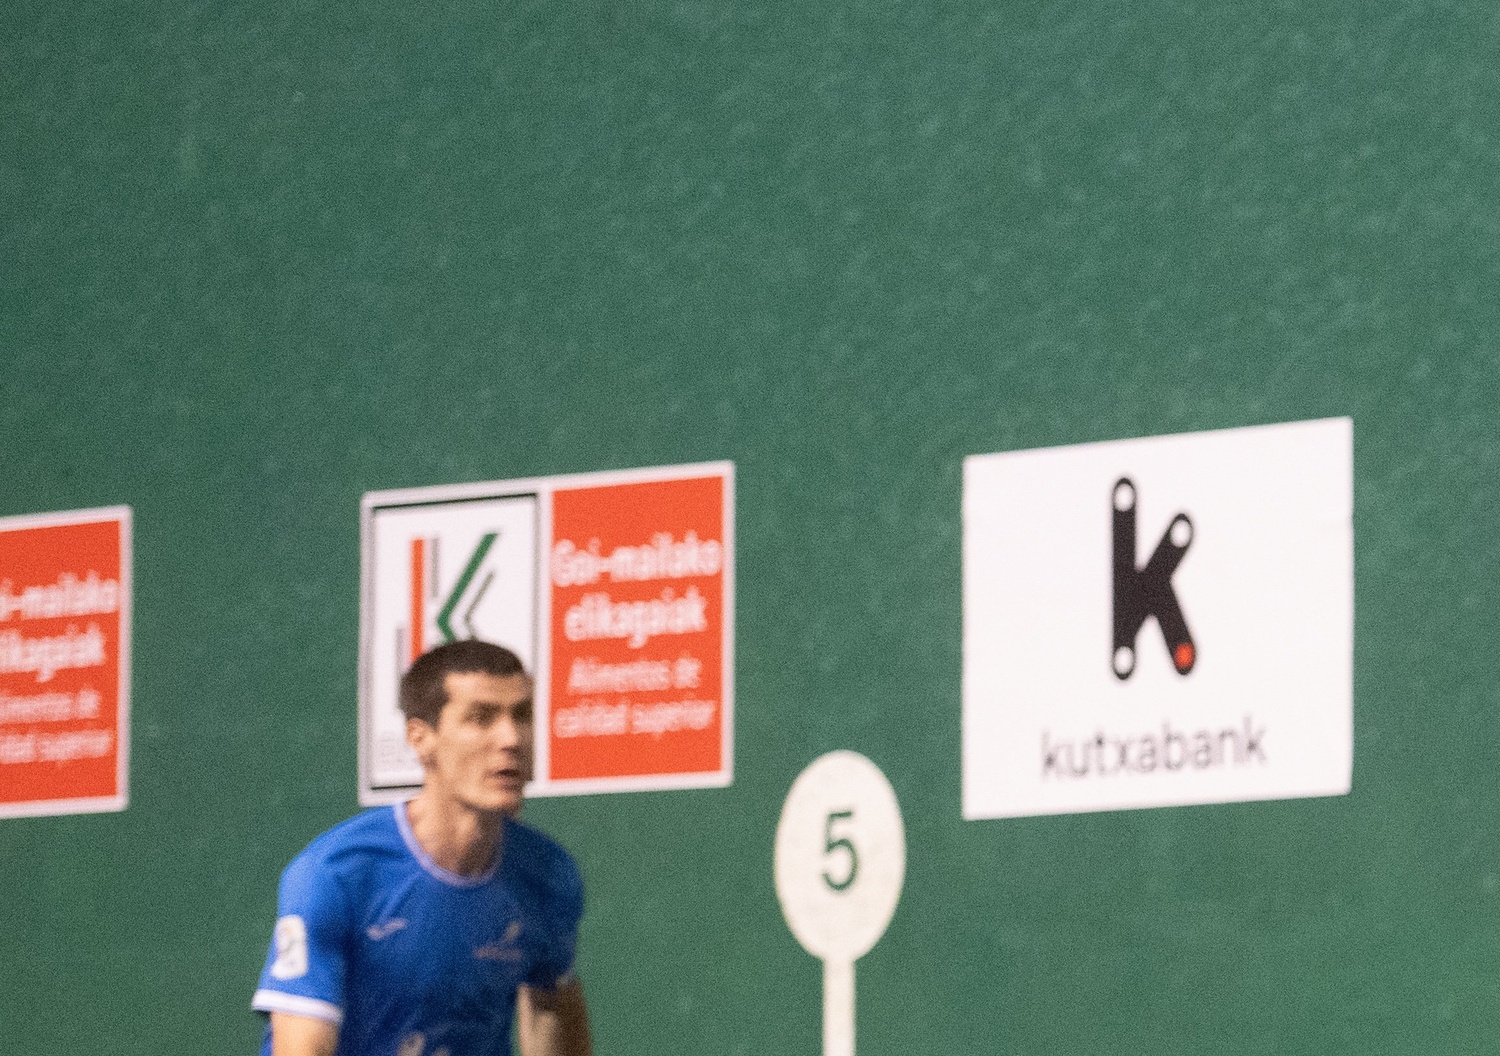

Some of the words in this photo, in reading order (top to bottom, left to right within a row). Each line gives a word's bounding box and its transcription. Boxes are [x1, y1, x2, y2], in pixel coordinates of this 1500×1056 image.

[564, 586, 709, 649] elikagaiak
[1040, 714, 1267, 782] kutxabank
[821, 809, 860, 893] 5
